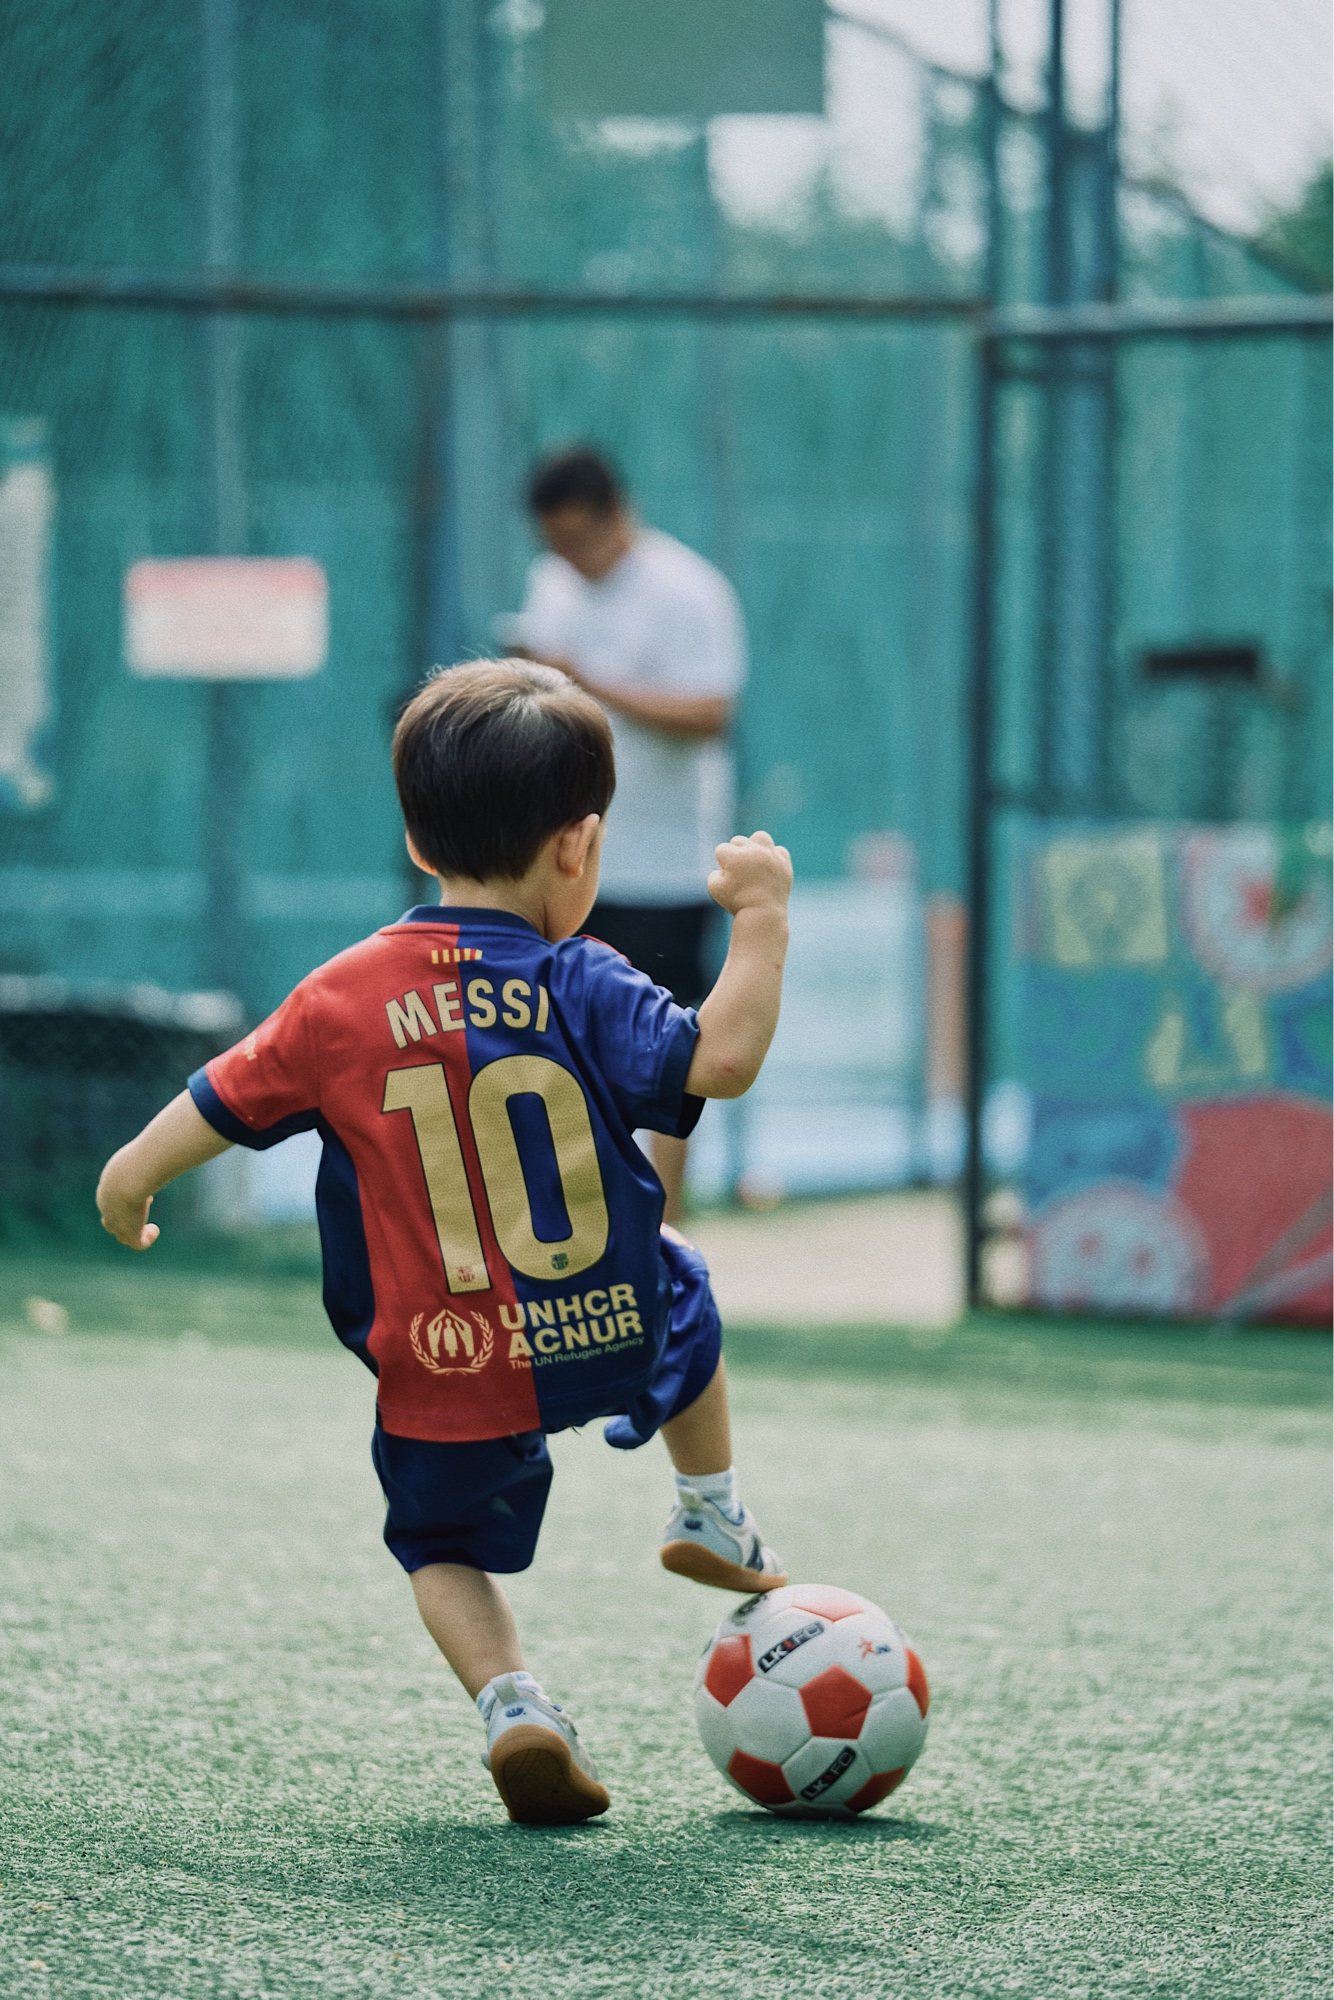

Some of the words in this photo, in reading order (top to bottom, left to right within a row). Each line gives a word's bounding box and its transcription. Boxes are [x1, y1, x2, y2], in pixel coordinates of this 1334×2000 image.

[384, 978, 550, 1049] MESSI
[382, 1054, 610, 1295] 10
[498, 1283, 638, 1330] UNHCR
[508, 1310, 643, 1358] ACNUR
[510, 1359, 532, 1369] The
[534, 1355, 553, 1367] UN
[555, 1347, 602, 1363] Refugee
[604, 1337, 645, 1353] Agency
